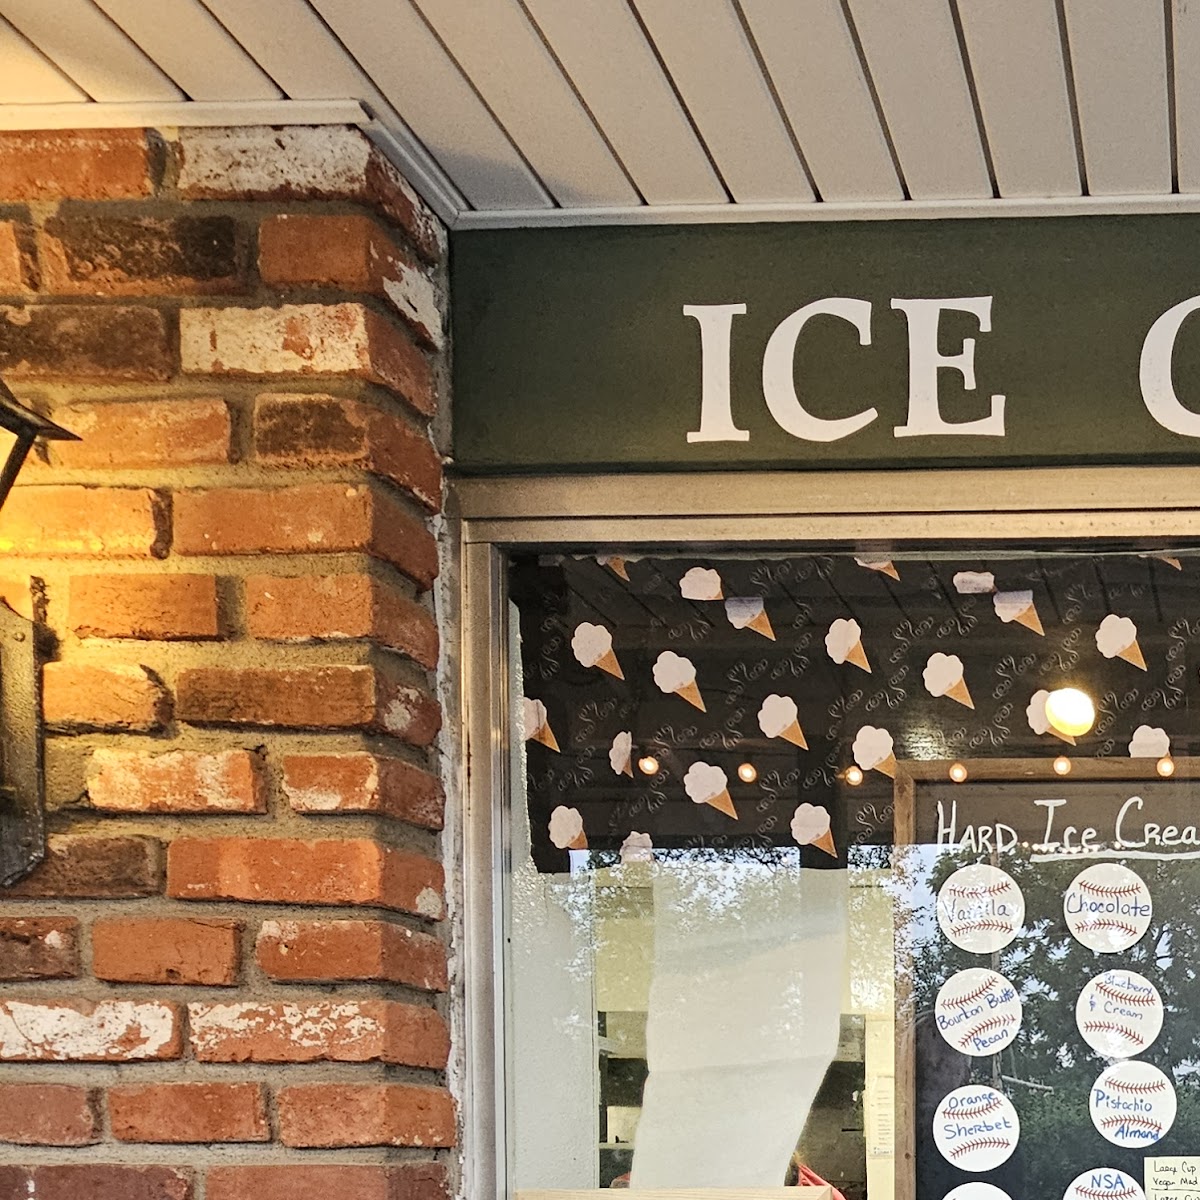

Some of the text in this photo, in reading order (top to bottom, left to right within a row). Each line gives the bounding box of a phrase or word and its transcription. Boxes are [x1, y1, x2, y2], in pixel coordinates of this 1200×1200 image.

[683, 295, 1006, 444] ICE
[1034, 799, 1100, 852] Ice
[1066, 892, 1151, 918] Chocolate
[1103, 1000, 1143, 1021] Cream
[972, 1029, 1010, 1052] Pecan
[948, 1090, 996, 1110] Orange
[1093, 1088, 1153, 1112] Pistachio
[1113, 1123, 1162, 1142] Almond
[1181, 1160, 1197, 1176] Cup
[1090, 1174, 1126, 1190] NSA
